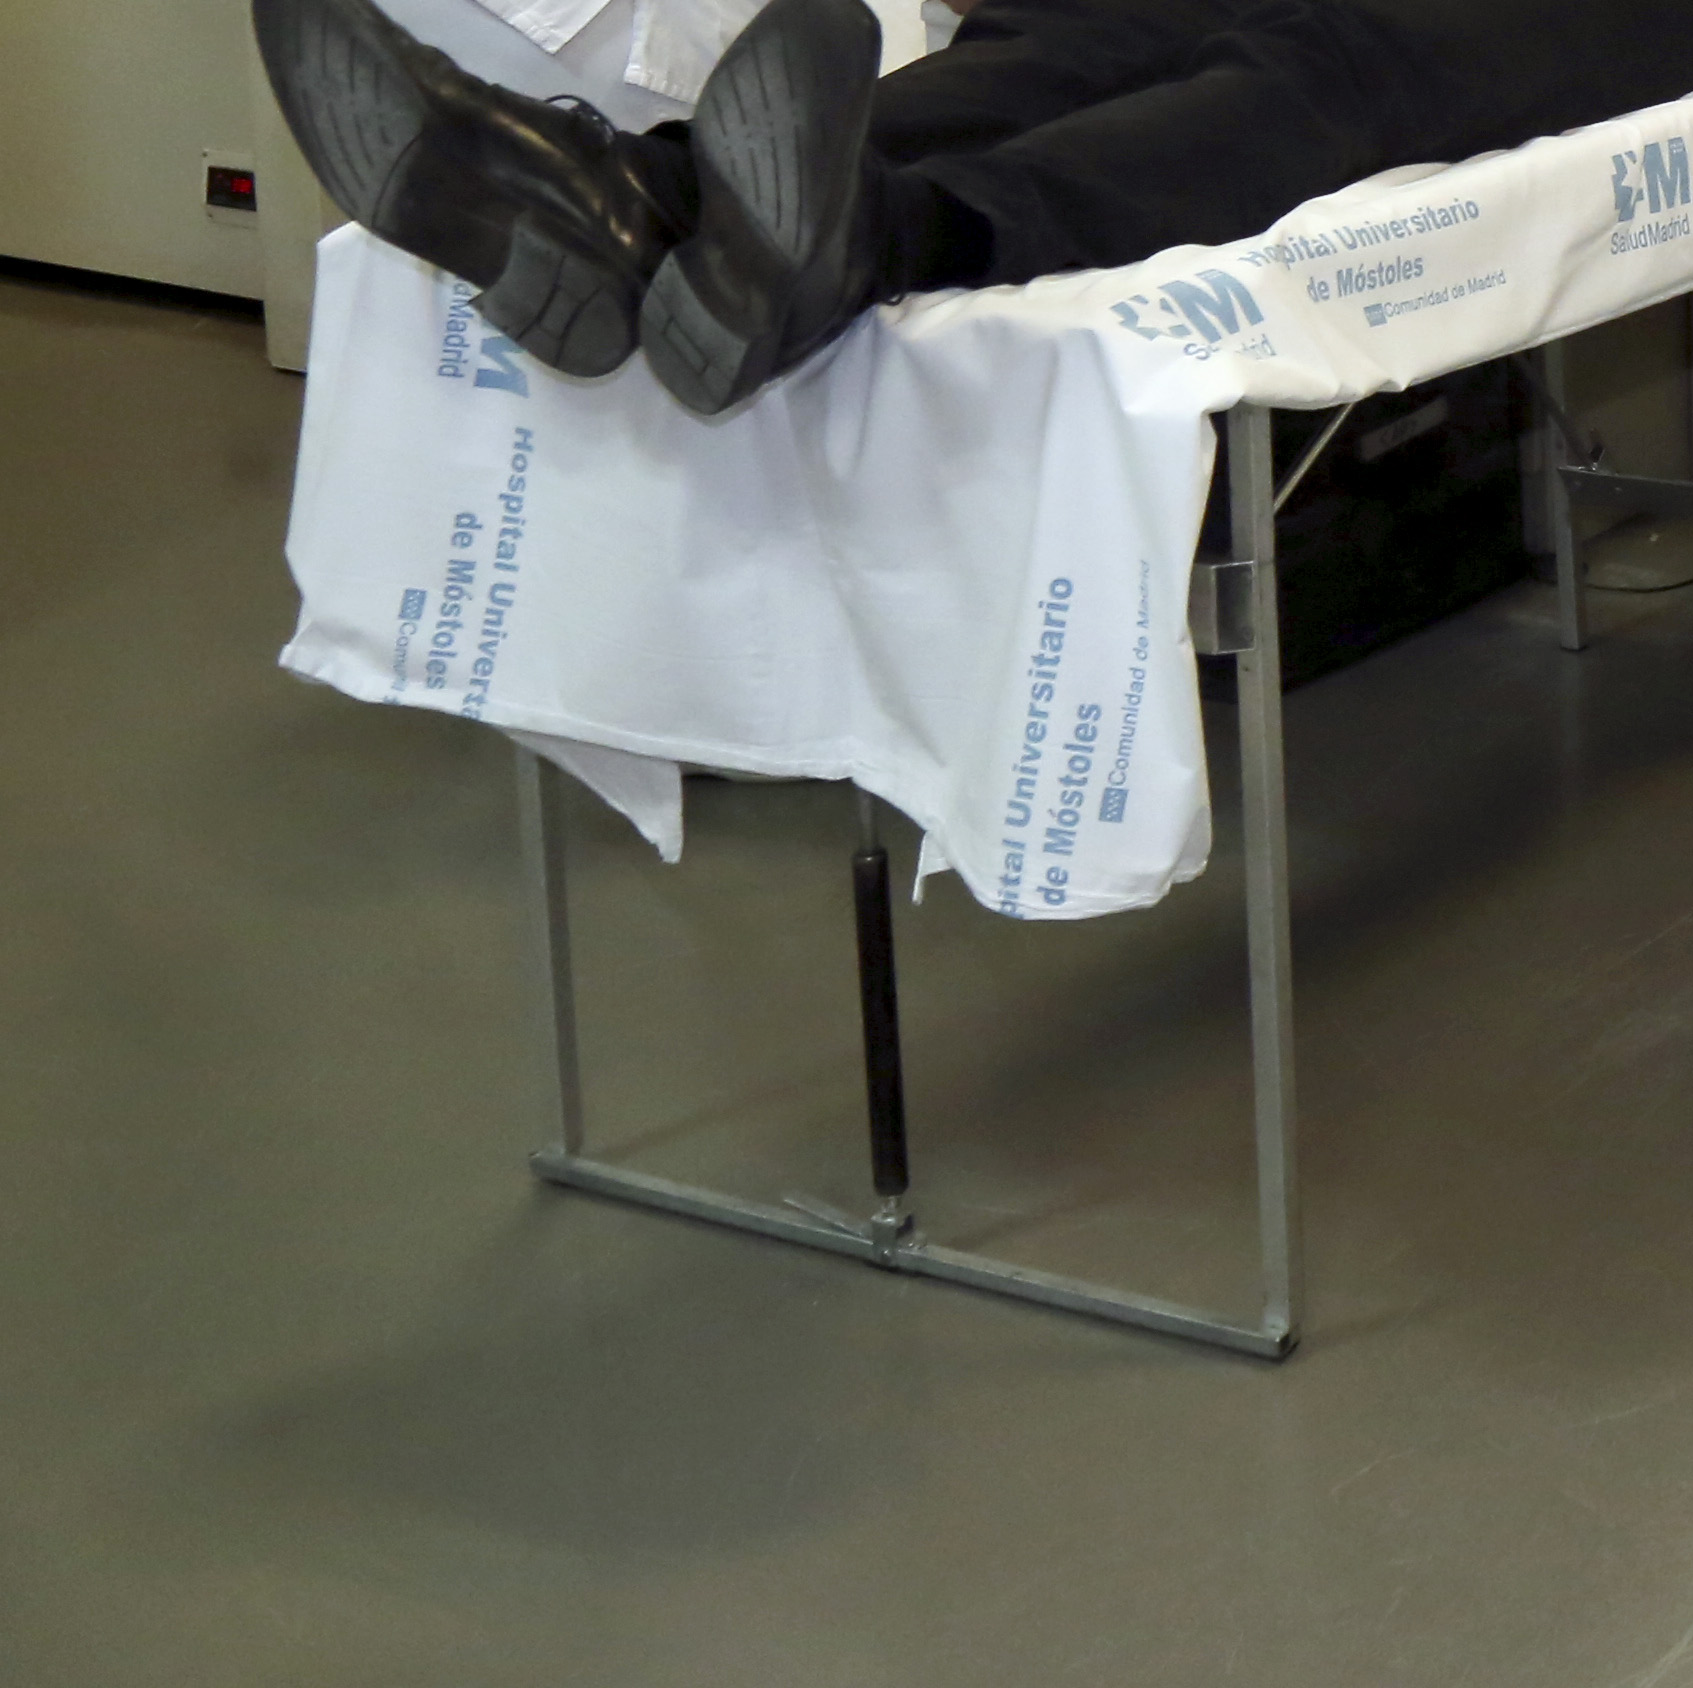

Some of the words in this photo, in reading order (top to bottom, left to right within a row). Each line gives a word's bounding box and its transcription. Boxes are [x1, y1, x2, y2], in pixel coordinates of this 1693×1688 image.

[1333, 198, 1480, 253] Universitario
[1610, 214, 1690, 255] SaludMadrid
[1307, 275, 1330, 304] de
[1337, 255, 1424, 294] Móstoles
[1384, 289, 1449, 318] Comunidad
[1452, 284, 1466, 300] de
[1468, 269, 1507, 293] Madrid
[451, 512, 483, 549] de
[493, 426, 534, 573] Hospital
[426, 559, 476, 689] Móstoles
[1136, 560, 1150, 629] Madrid
[1132, 636, 1149, 661] de
[1004, 576, 1074, 828] Universitario
[1107, 667, 1147, 785] Comunidad
[1043, 703, 1103, 857] Móstoles
[999, 839, 1027, 919] pital
[1036, 866, 1069, 906] de
